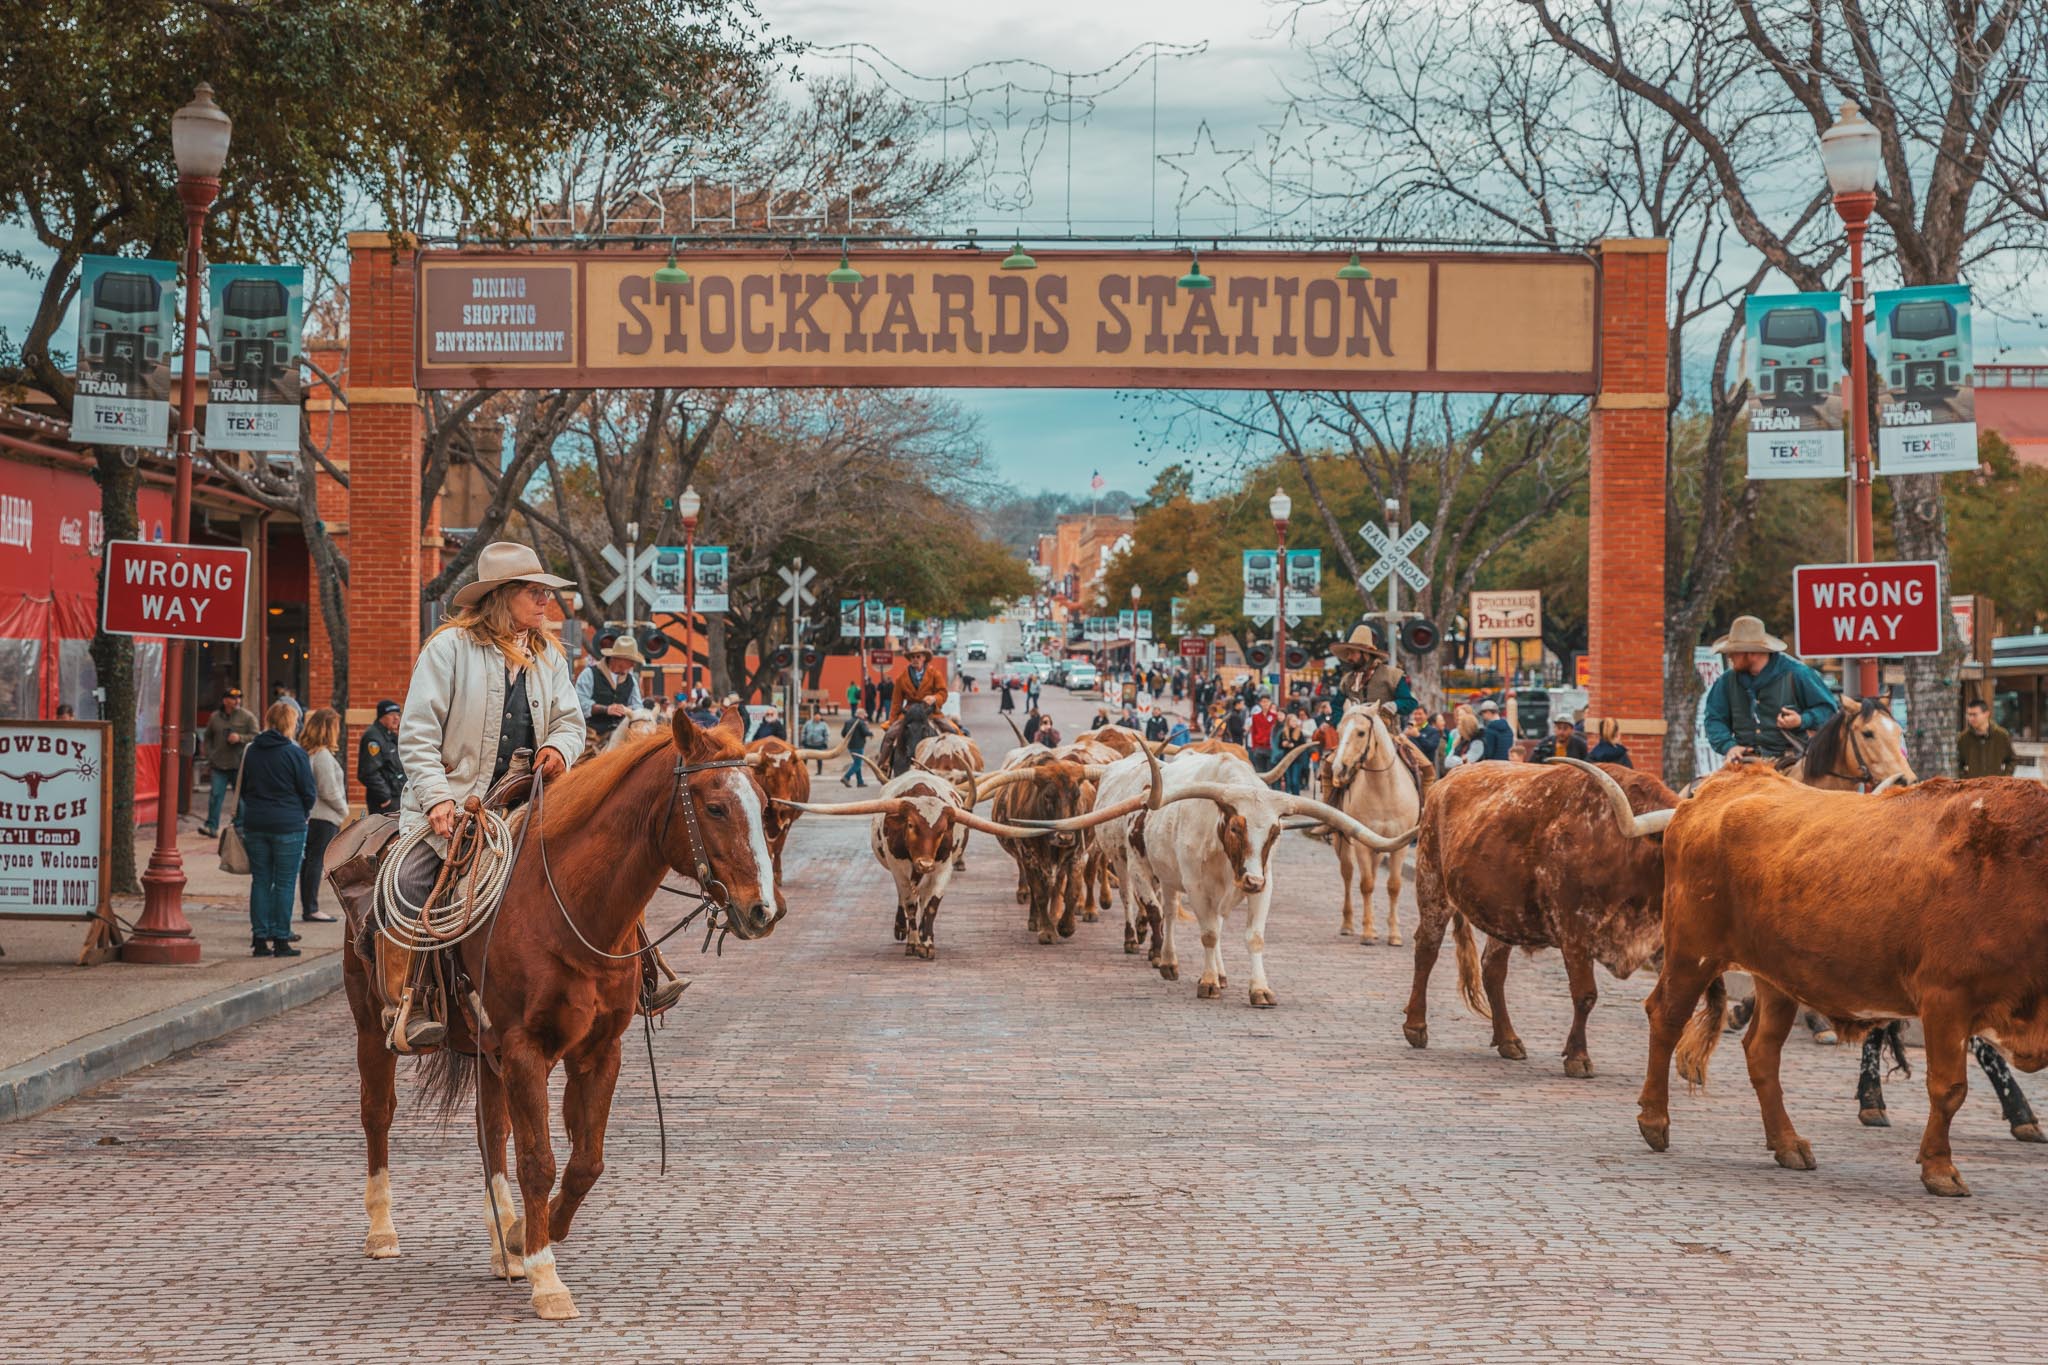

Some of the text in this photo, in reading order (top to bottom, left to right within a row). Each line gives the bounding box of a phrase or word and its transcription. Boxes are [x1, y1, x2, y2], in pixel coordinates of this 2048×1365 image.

[472, 278, 526, 299] DINING
[463, 305, 536, 325] SHOPPING
[617, 273, 1399, 358] STOCKYARDS STATION
[435, 331, 565, 352] ENTERTAINMENT
[79, 371, 117, 382] TIME TO
[212, 380, 248, 389] TIME TO
[78, 380, 127, 396] TRAIN
[211, 388, 258, 402] TRAIN
[1752, 408, 1789, 417] TIME TO
[1882, 409, 1932, 426] TRAIN
[1751, 416, 1800, 431] TRAIN
[124, 558, 233, 591] WRONG
[1812, 579, 1924, 608] WRONG
[142, 594, 210, 623] WAY
[1478, 613, 1535, 629] PARKING
[1832, 614, 1903, 641] WAY
[35, 830, 75, 844] Come!
[41, 851, 98, 869] Welcome
[33, 879, 57, 905] HIGH
[62, 880, 89, 906] NOON
